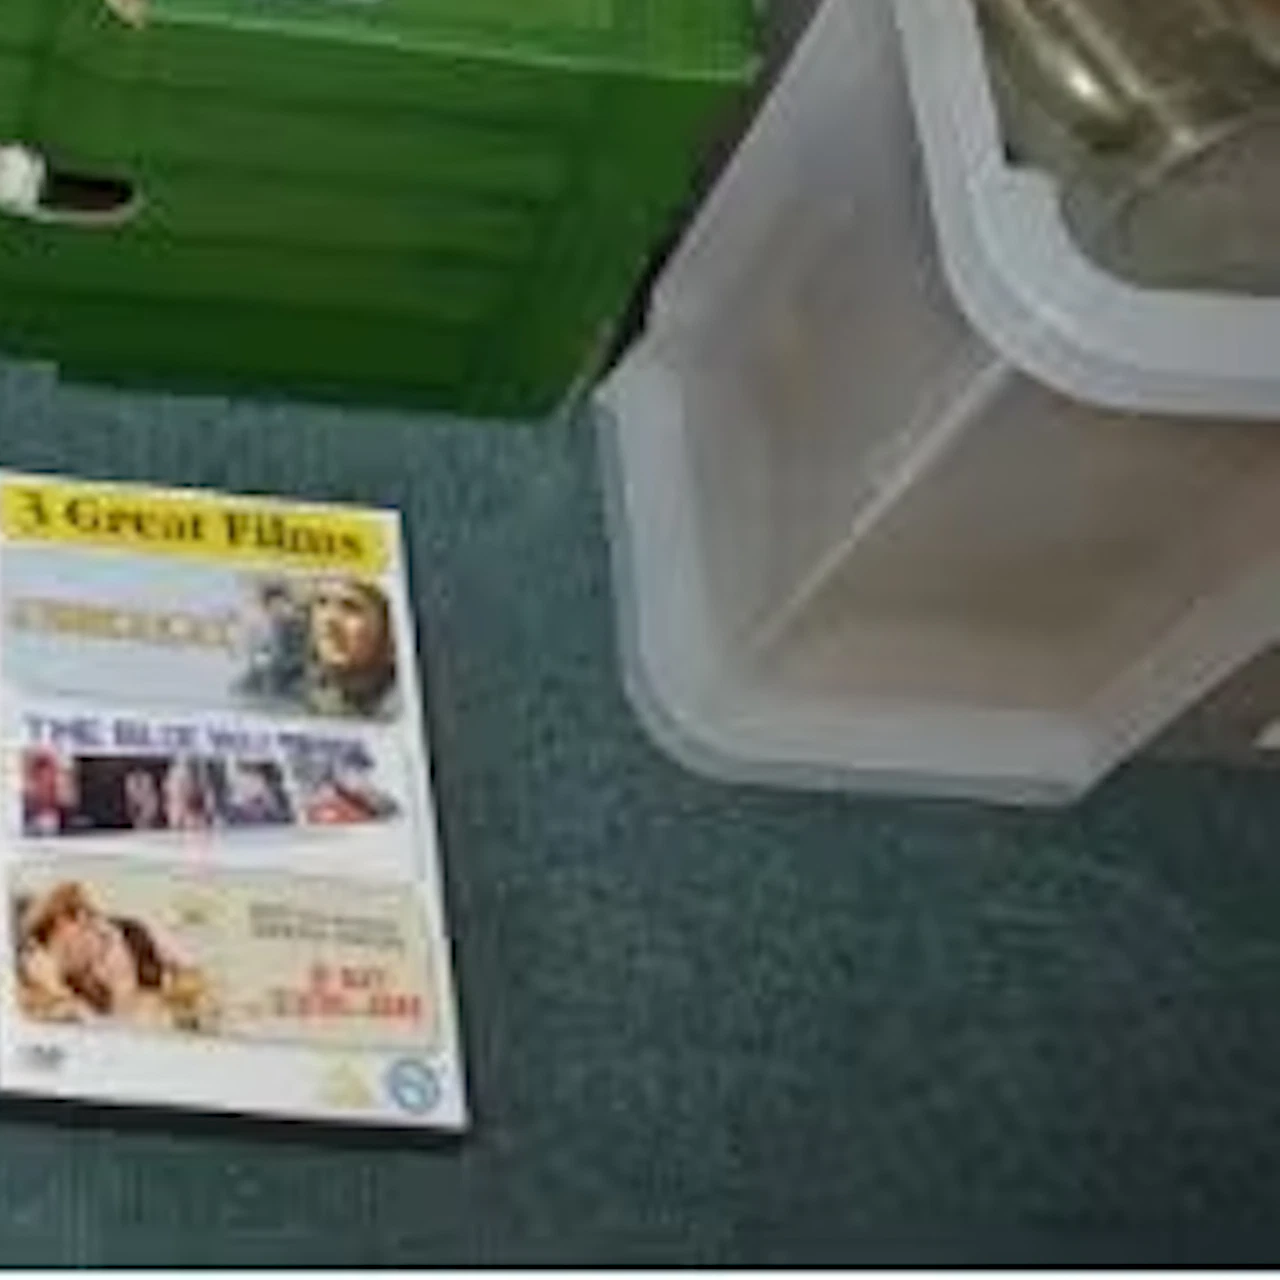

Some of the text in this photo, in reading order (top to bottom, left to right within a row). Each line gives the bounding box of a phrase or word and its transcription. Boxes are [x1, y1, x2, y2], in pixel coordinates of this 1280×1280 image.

[15, 488, 365, 561] 3 Great Films
